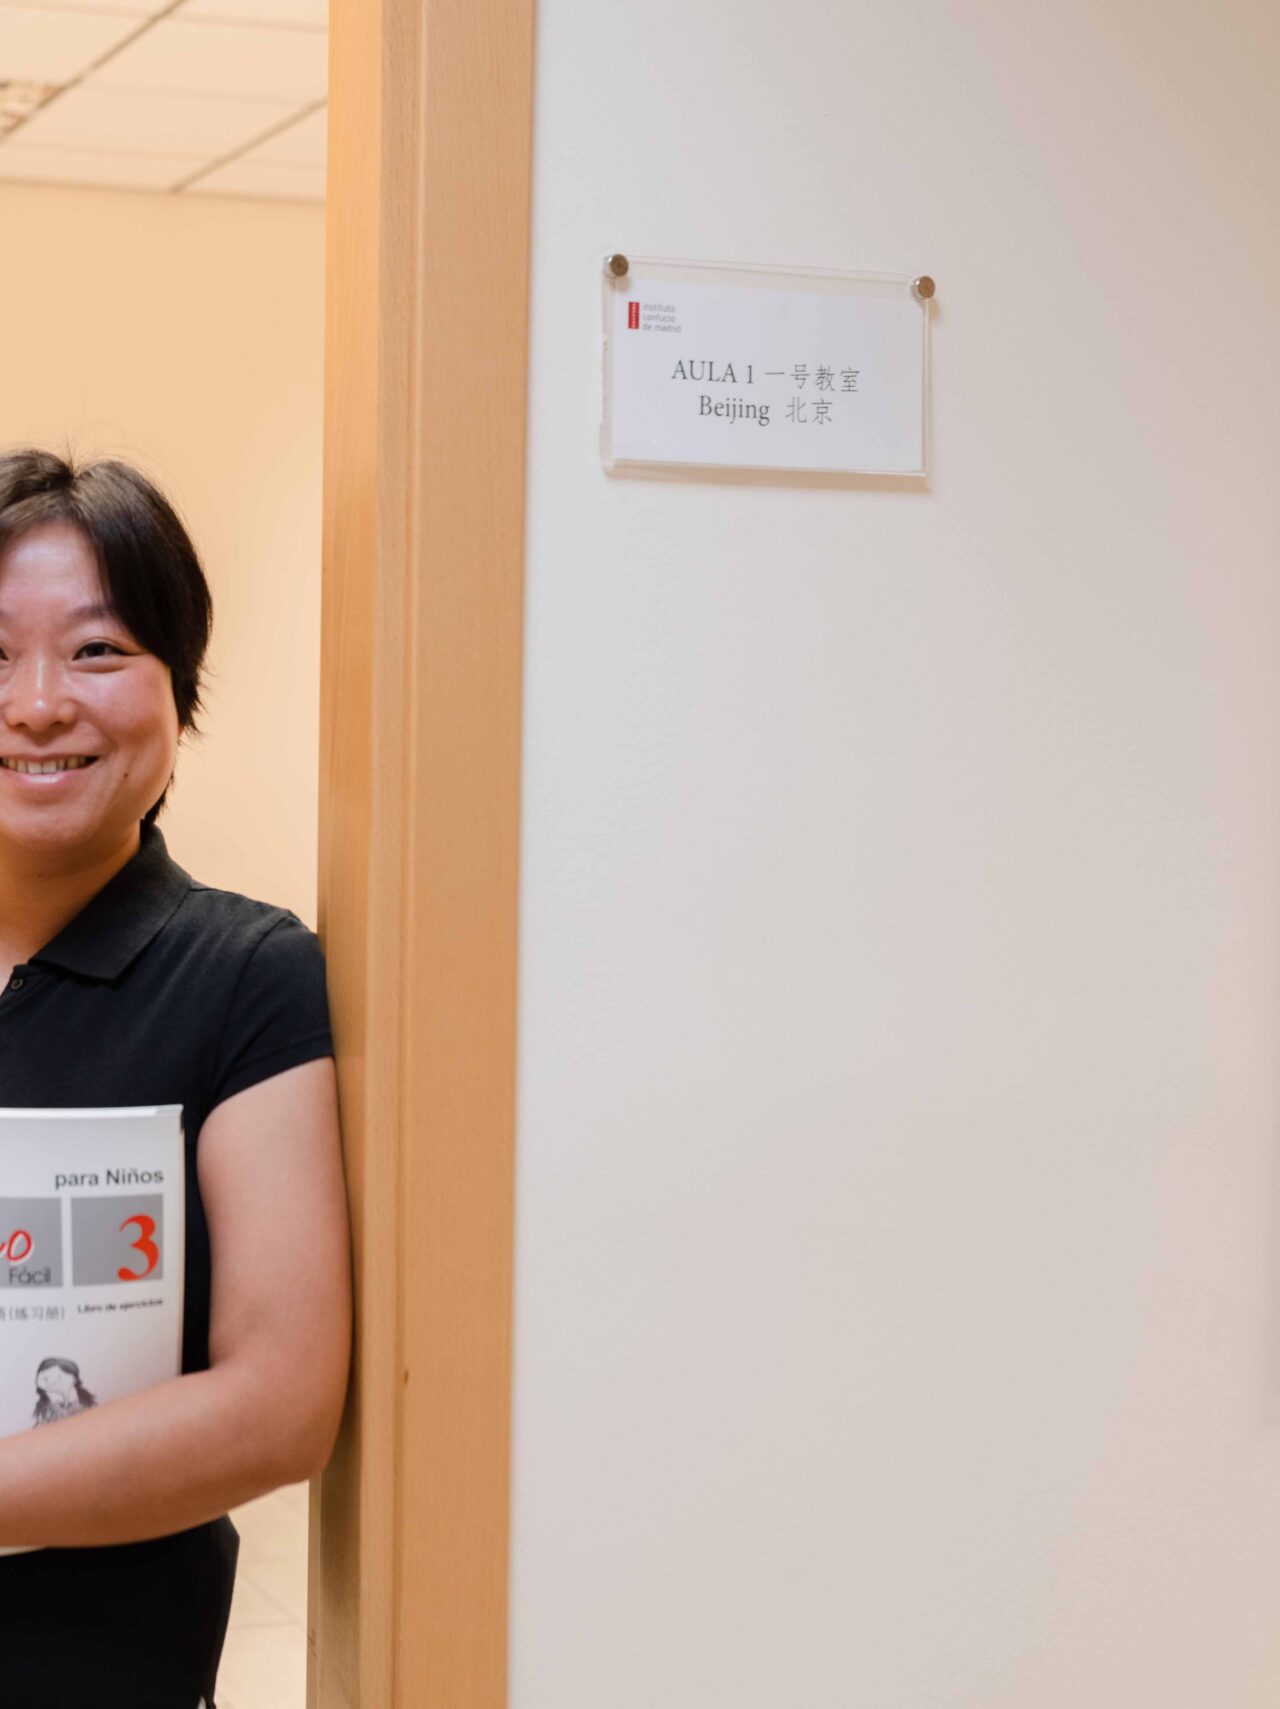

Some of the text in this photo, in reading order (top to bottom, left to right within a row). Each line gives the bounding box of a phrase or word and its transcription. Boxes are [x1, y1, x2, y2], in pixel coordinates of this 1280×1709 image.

[642, 303, 676, 314] instituto
[642, 313, 676, 324] confucio
[642, 322, 682, 334] de madrid
[671, 359, 861, 393] AULA 1 一号教室
[698, 395, 834, 427] Beijing 北京
[55, 1167, 164, 1191] para Niños
[117, 1212, 160, 1281] 3
[9, 1266, 52, 1285] Fácil
[78, 1303, 103, 1315] Libro
[105, 1302, 116, 1312] de
